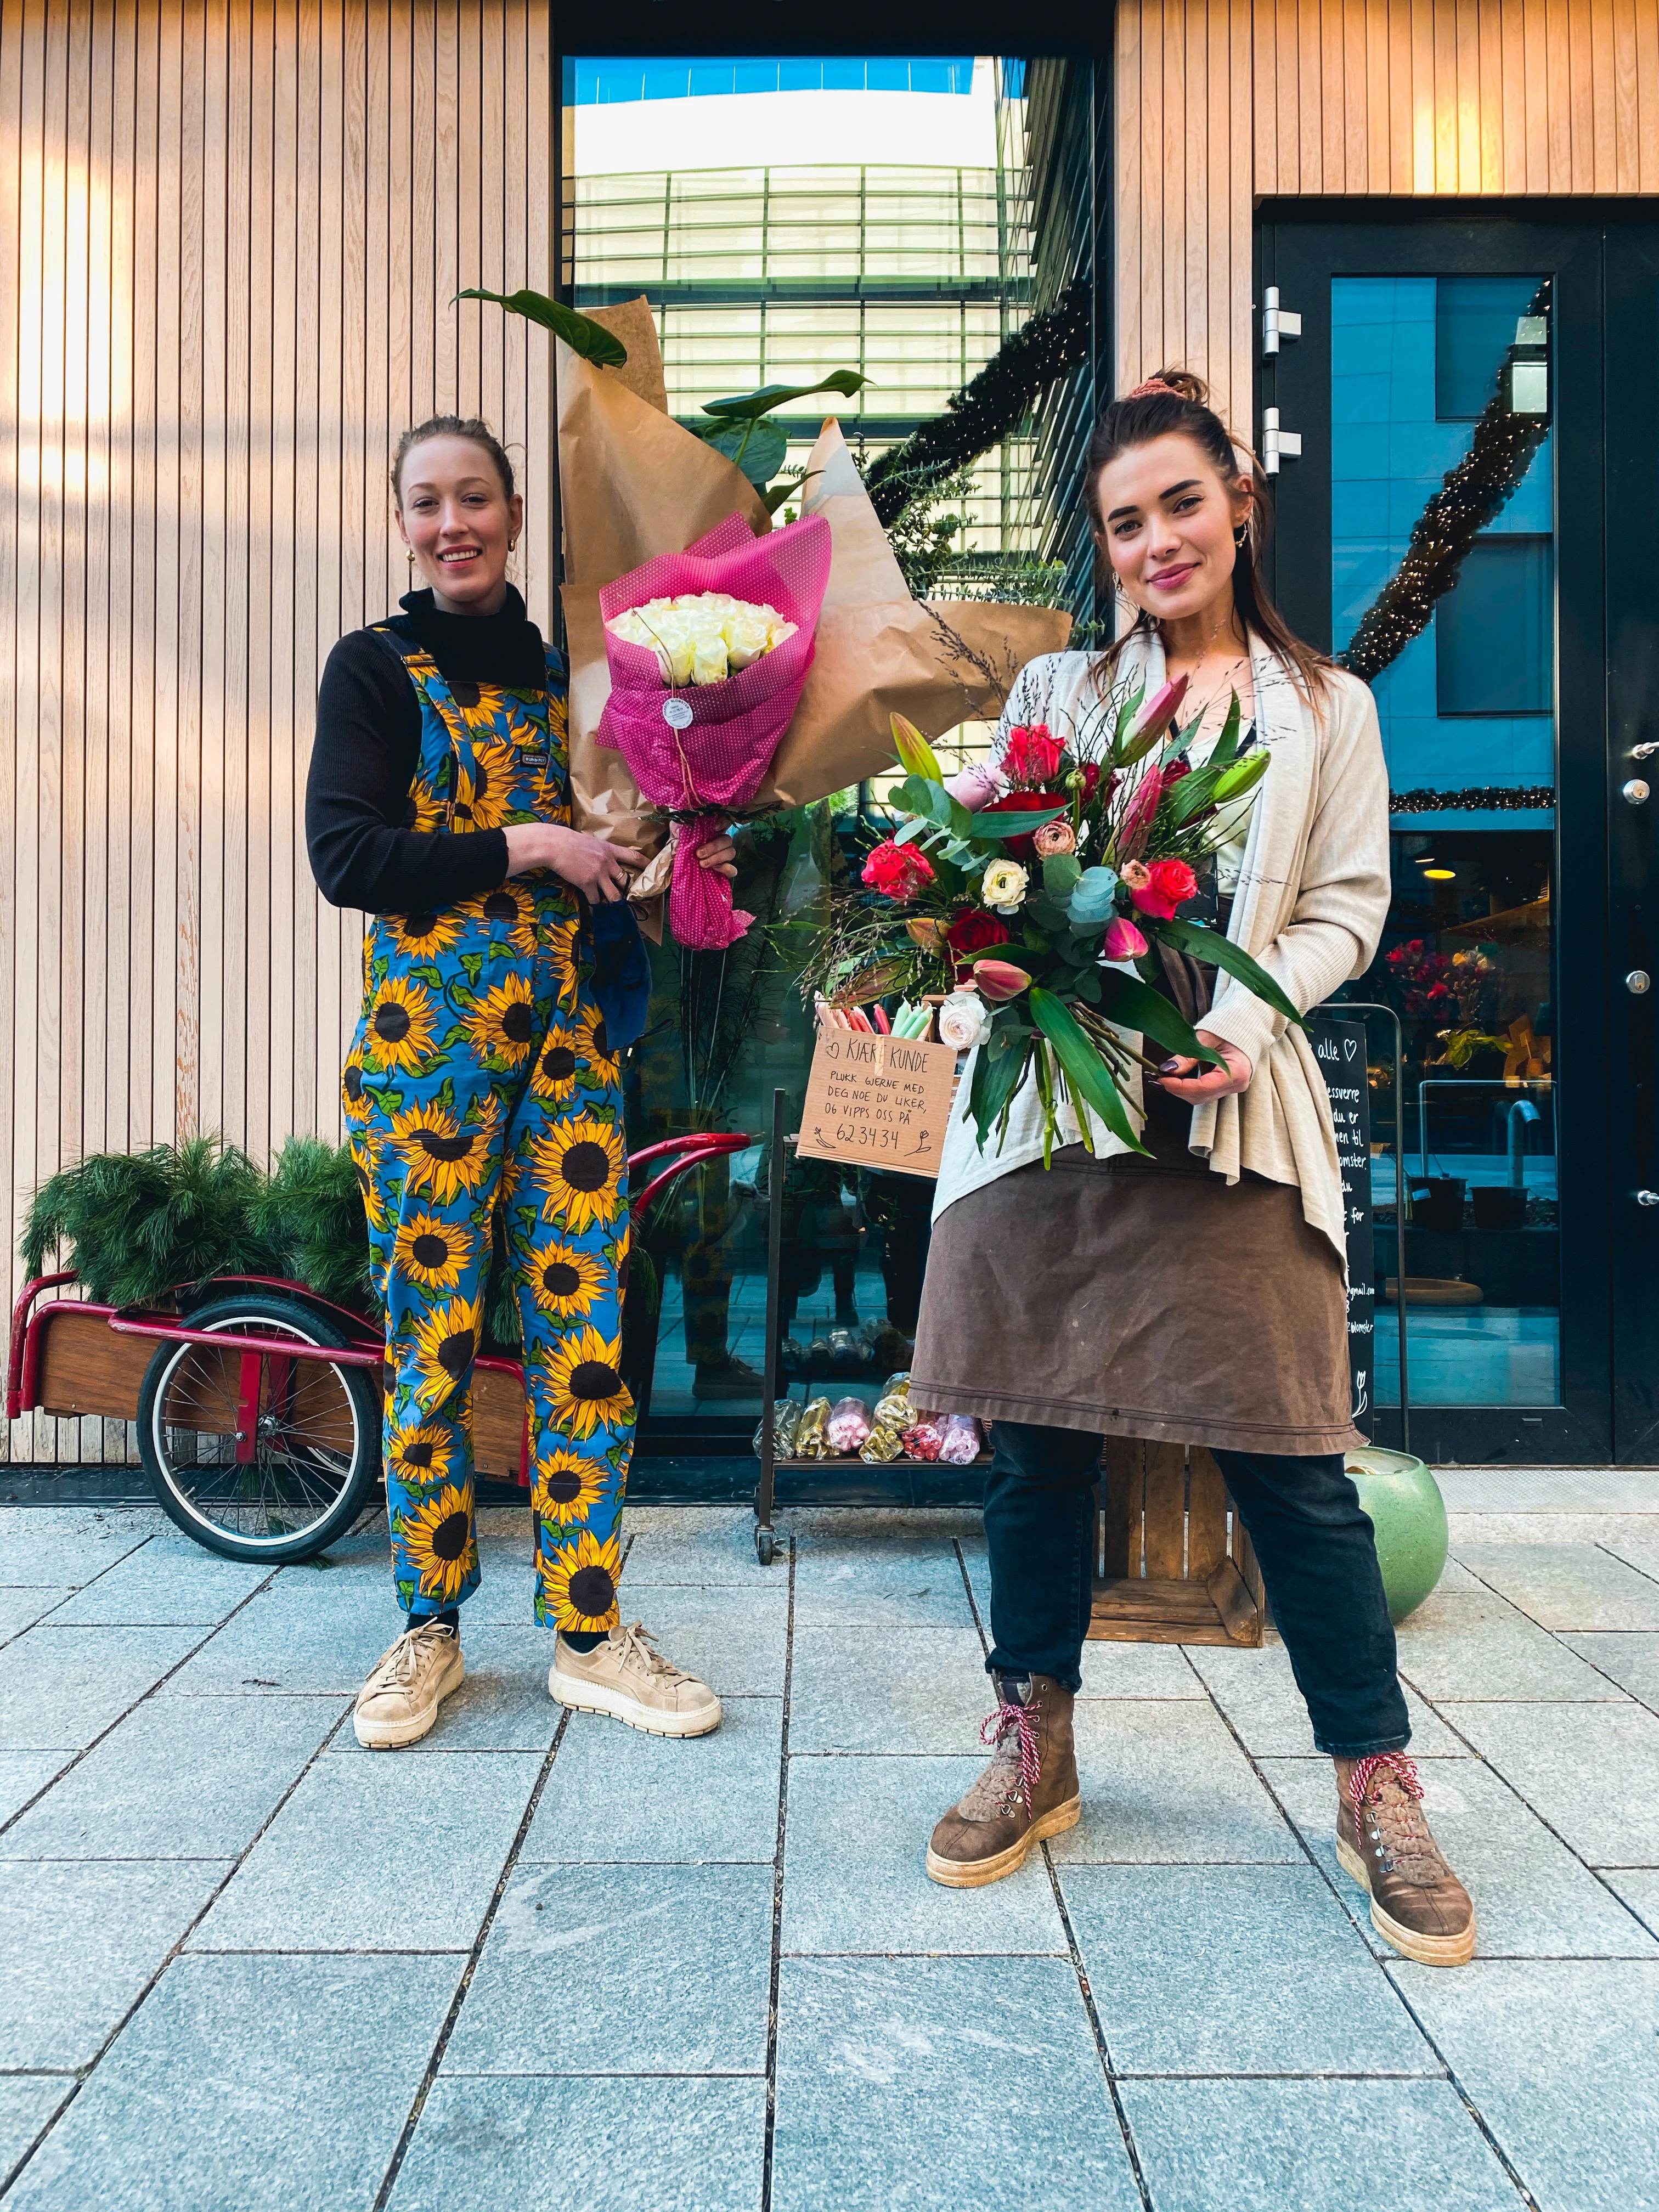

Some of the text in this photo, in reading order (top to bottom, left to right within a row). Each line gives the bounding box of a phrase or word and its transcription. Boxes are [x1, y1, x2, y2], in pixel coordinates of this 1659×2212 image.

[847, 1037, 929, 1073] KJÆRE KUNDE
[1318, 1037, 1340, 1061] alle
[830, 1071, 924, 1094] PLUKK GJERNE MED
[1324, 1082, 1360, 1103] essverre
[828, 1085, 849, 1098] DEG
[852, 1090, 871, 1102] NOE
[876, 1093, 888, 1103] DU
[843, 1105, 870, 1119] VIPPS
[876, 1109, 893, 1122] OSS
[899, 1109, 912, 1125] PÅ
[1333, 1108, 1359, 1125] du er
[837, 1124, 899, 1149] 623434
[1352, 1128, 1364, 1147] til
[1339, 1152, 1367, 1170] omster.
[1351, 1207, 1364, 1224] for
